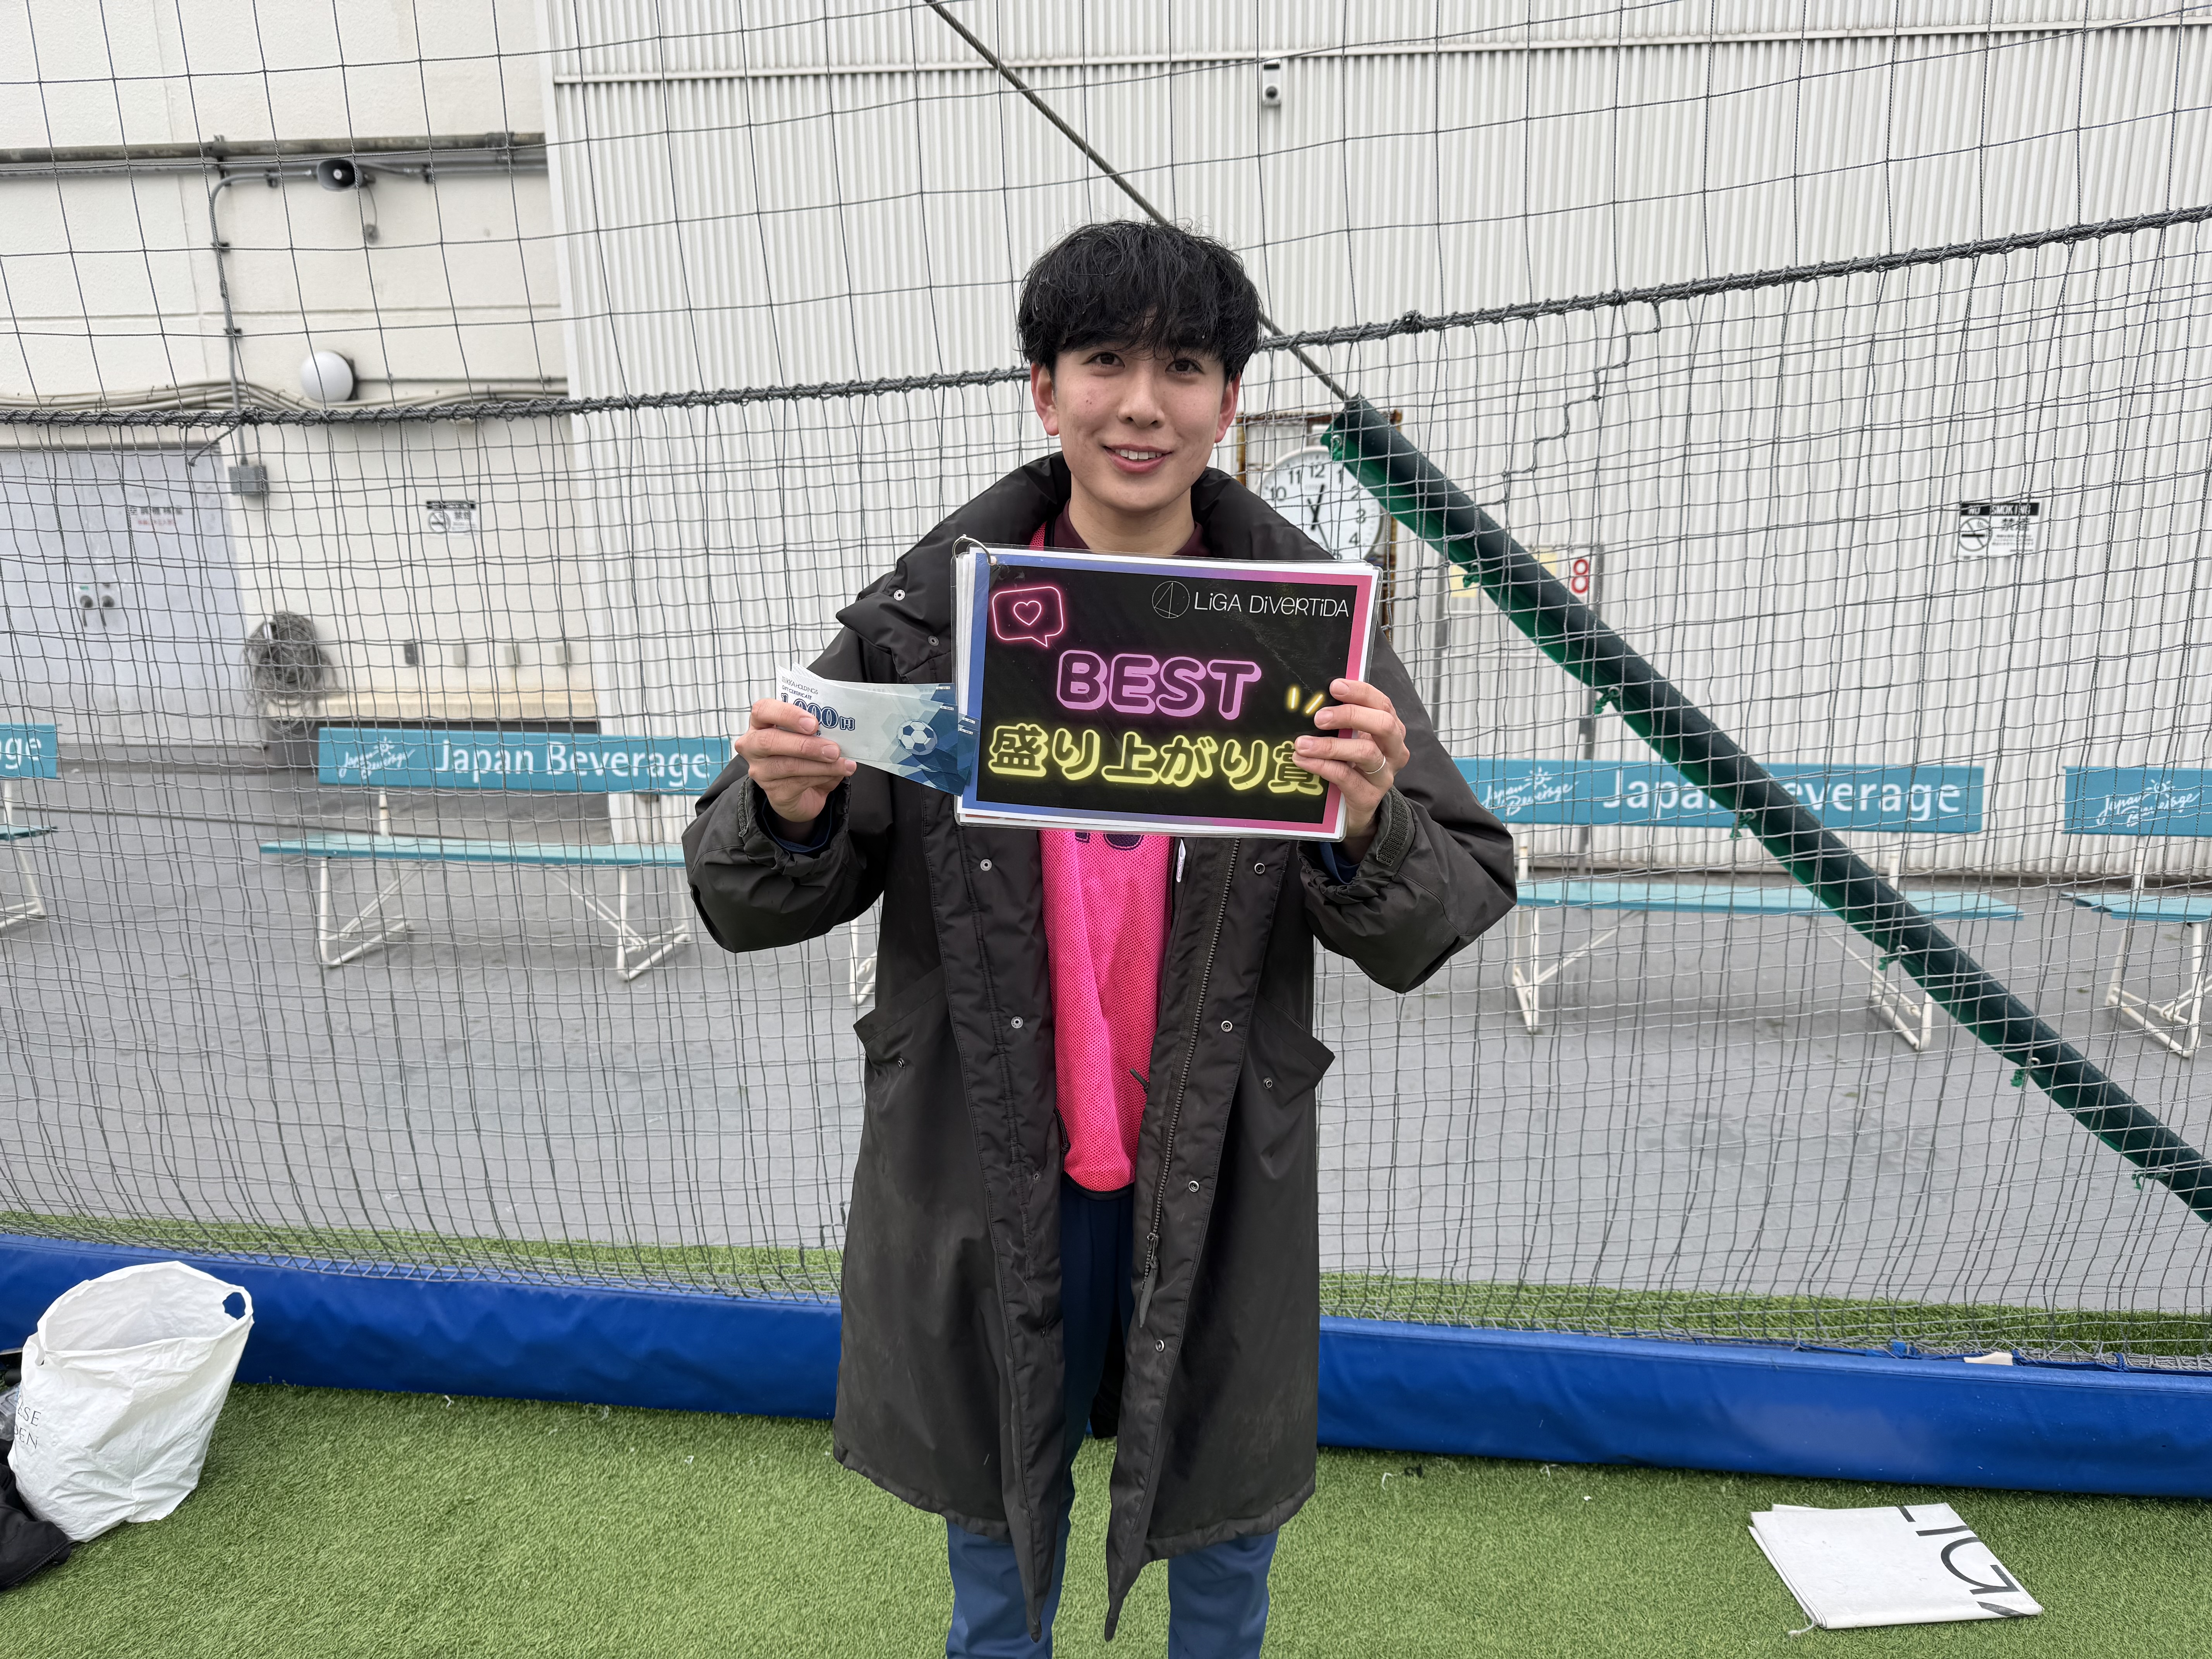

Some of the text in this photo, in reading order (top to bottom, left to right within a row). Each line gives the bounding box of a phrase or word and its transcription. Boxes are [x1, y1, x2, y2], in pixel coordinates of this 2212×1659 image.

[1288, 469, 1301, 484] 11
[1309, 463, 1325, 478] 12
[1338, 468, 1343, 483] 1
[1270, 486, 1286, 501] 10
[1351, 485, 1360, 500] 2
[1356, 508, 1366, 523] 3
[1968, 504, 2032, 515] NO SMOKING
[1348, 532, 1359, 546] 4
[1571, 558, 1589, 594] 8
[795, 683, 818, 695] HOLDINGS
[1056, 649, 1262, 721] BEST
[0, 738, 41, 769] ge
[988, 723, 1324, 795] 盛り上がり賞
[435, 739, 711, 788] Japan Beverage
